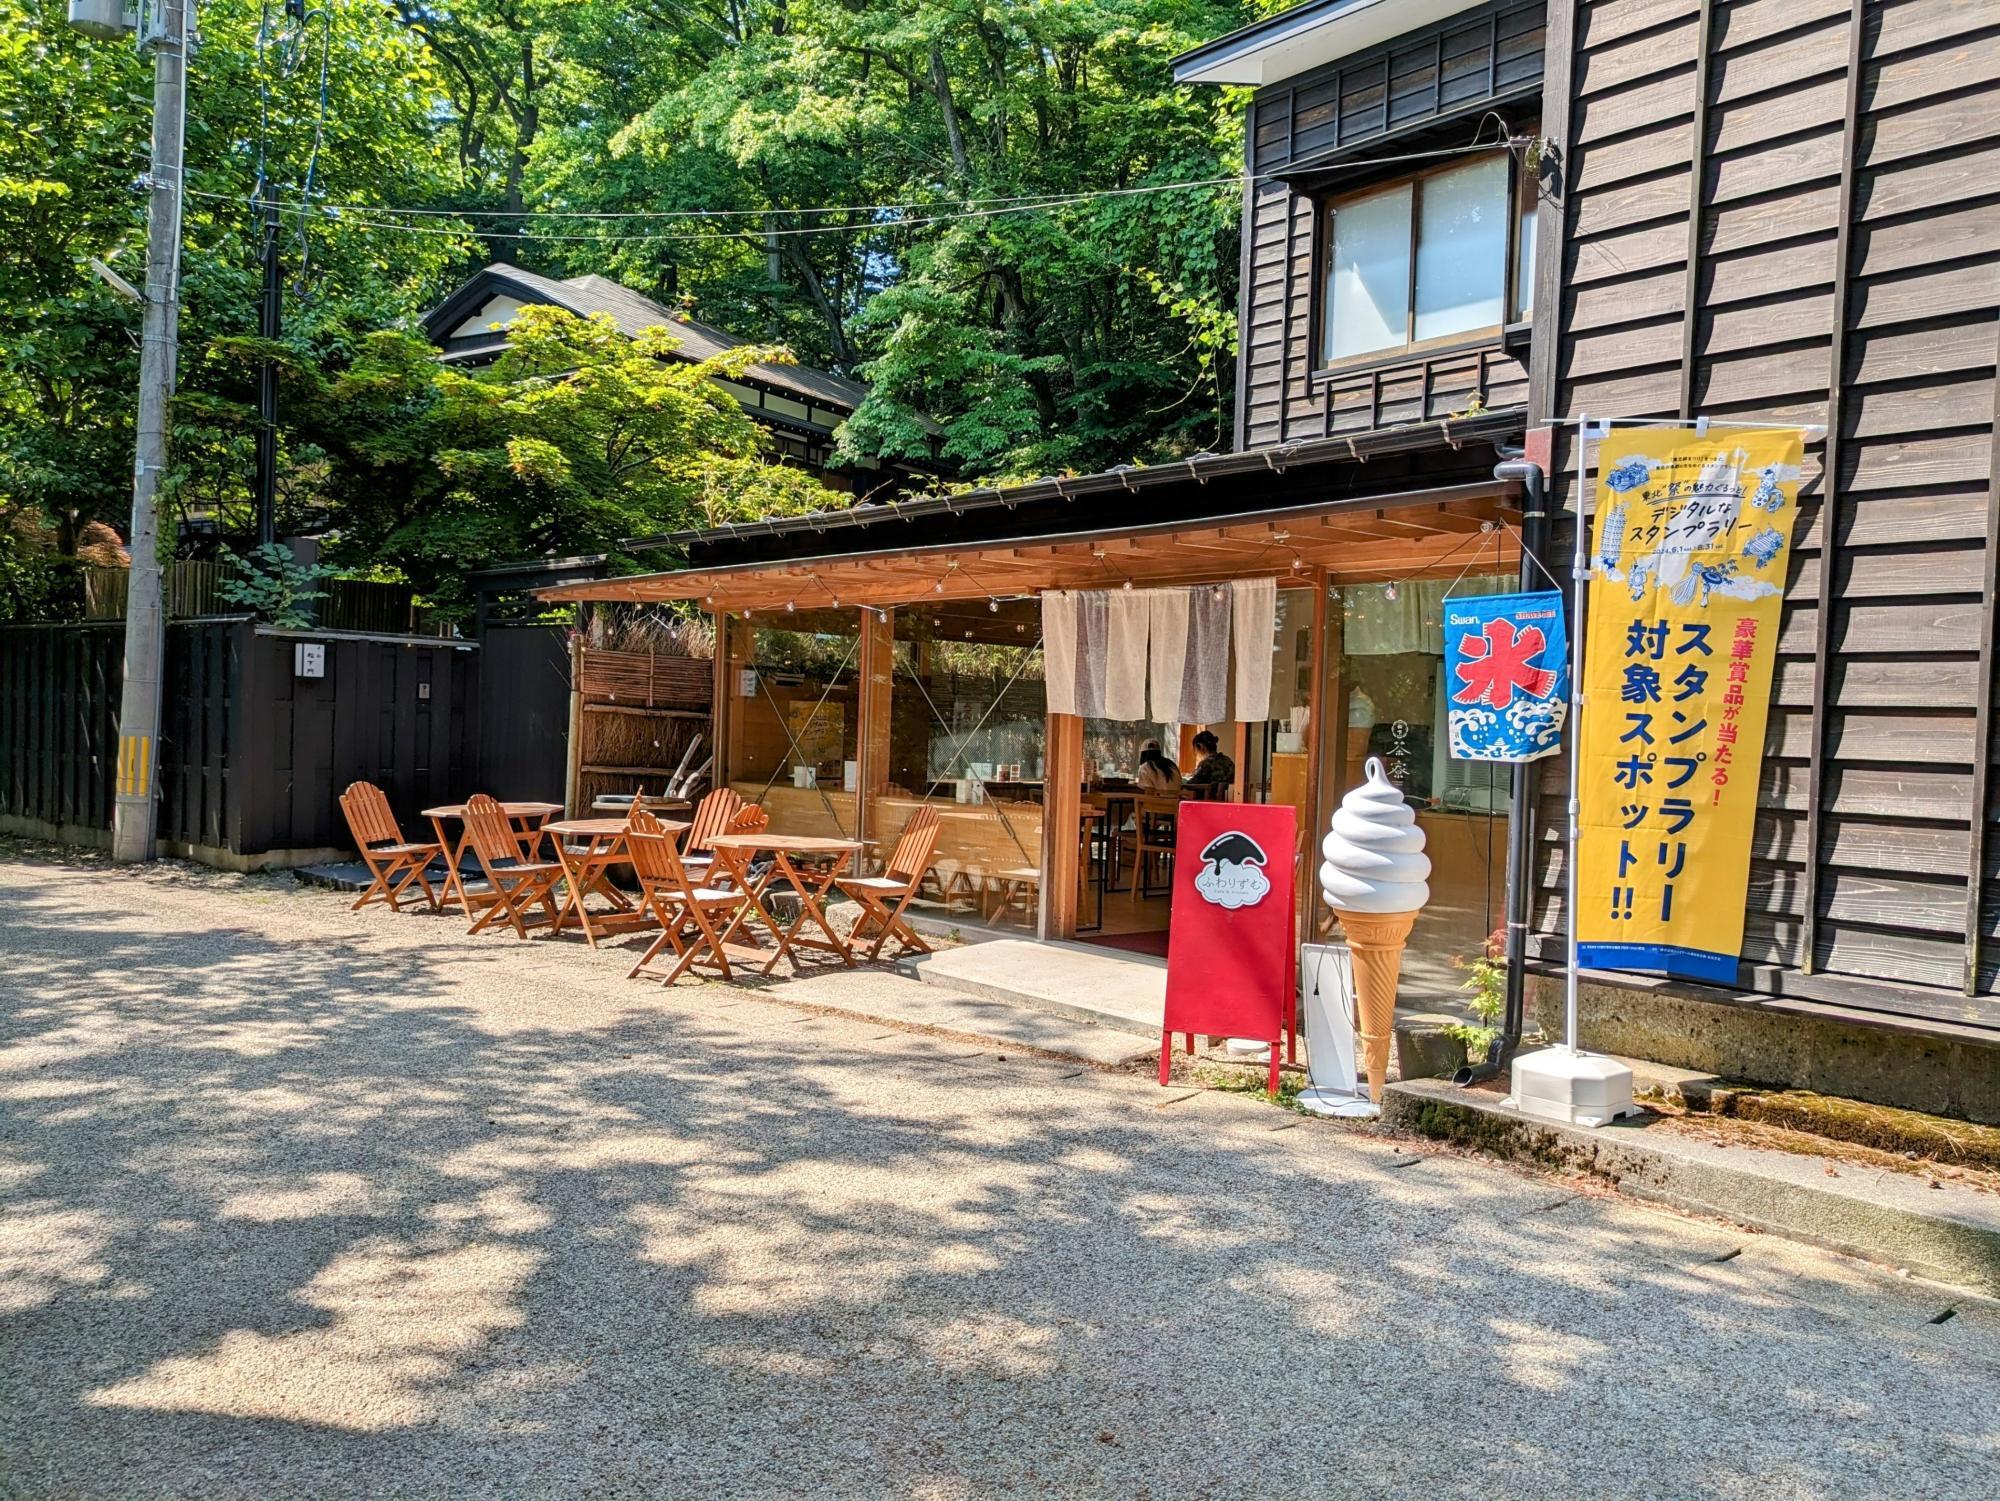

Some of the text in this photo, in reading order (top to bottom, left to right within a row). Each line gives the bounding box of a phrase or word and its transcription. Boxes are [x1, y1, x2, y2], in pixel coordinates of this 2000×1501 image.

[1630, 517, 1752, 545] スタンプラリー
[1651, 501, 1733, 523] デジタルな
[1452, 617, 1558, 710] 氷
[1711, 617, 1759, 806] 豪華賞品が当たる！
[1657, 622, 1714, 922] スタンプラリー
[1203, 876, 1261, 890] ふわりずむ
